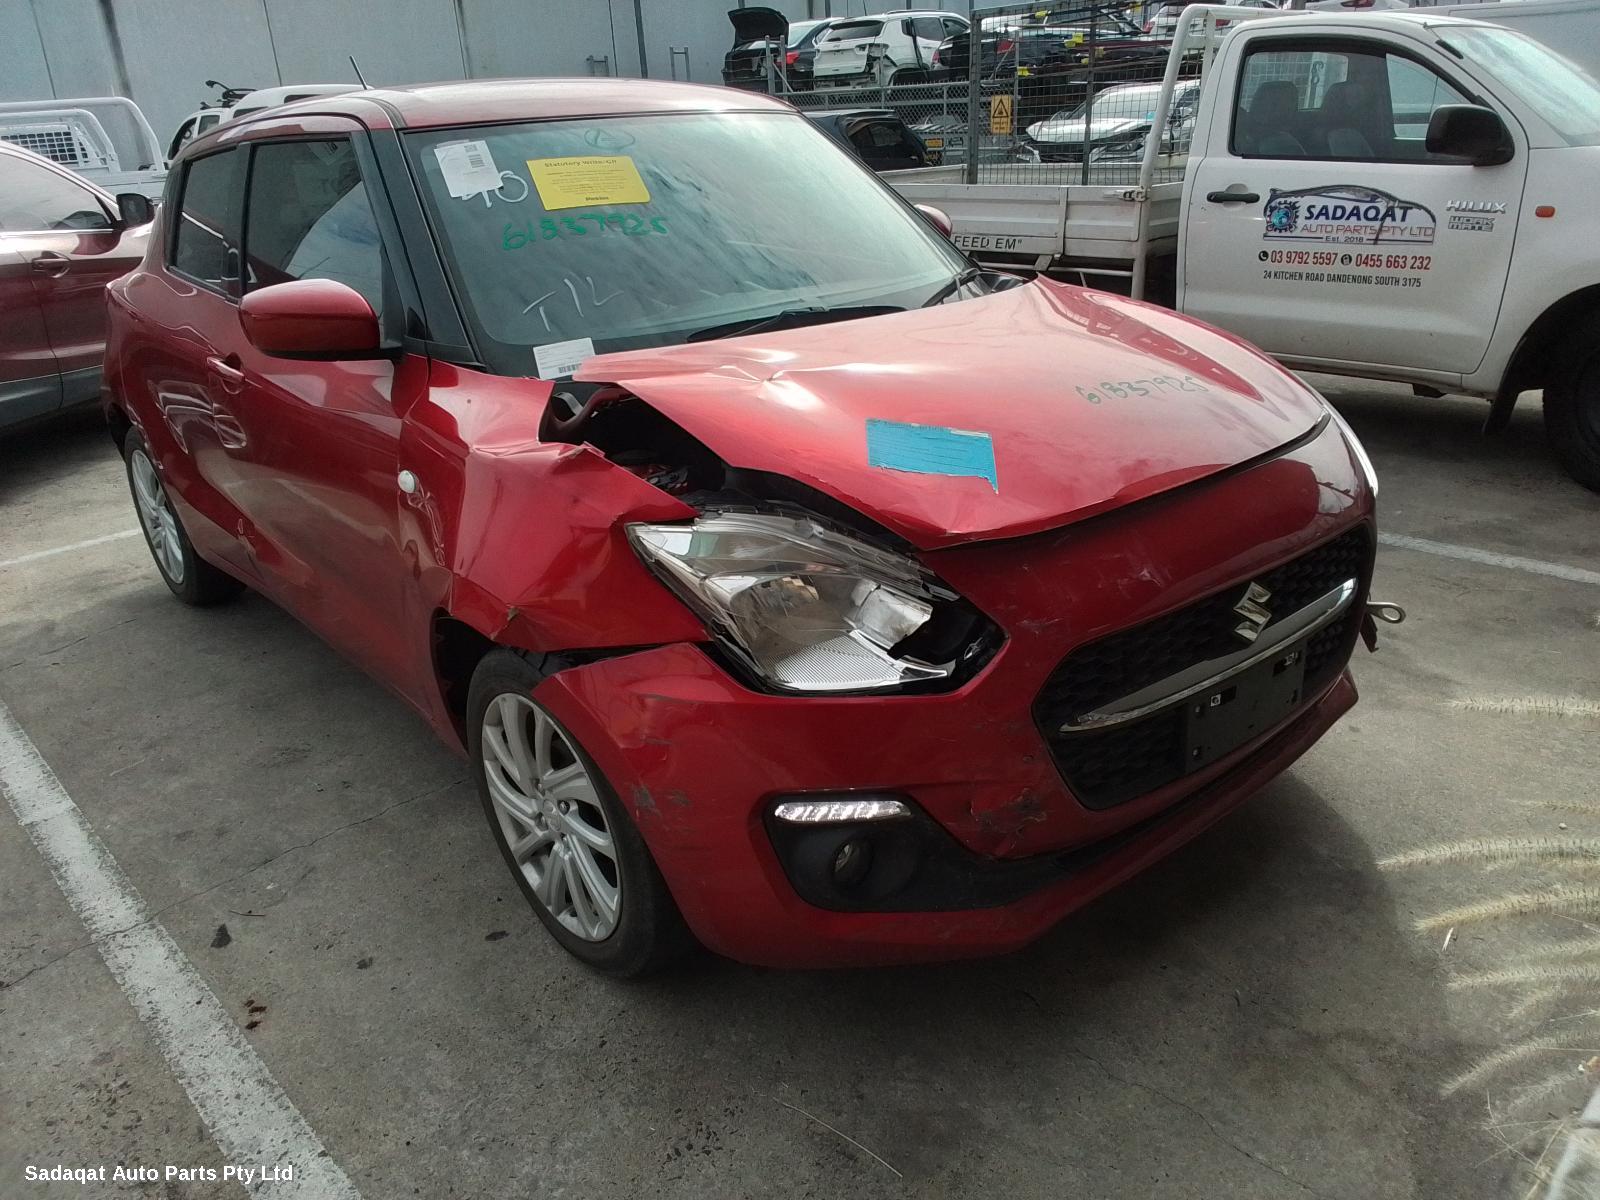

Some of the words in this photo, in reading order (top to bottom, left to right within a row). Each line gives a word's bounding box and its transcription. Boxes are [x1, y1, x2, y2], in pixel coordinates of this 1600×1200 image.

[1304, 204, 1414, 223] SADAQAT
[1446, 200, 1507, 214] HILUX
[1301, 224, 1334, 234] AUTO
[1336, 224, 1377, 235] PARTS
[1380, 225, 1407, 236] PTY
[1409, 226, 1434, 237] LTD
[954, 235, 990, 249] FEED
[1270, 250, 1283, 264] 03
[1286, 251, 1309, 265] 9792
[1312, 252, 1338, 266] 5597
[1355, 253, 1383, 268] 0455
[1386, 254, 1407, 269] 663
[1409, 255, 1432, 270] 232
[1263, 270, 1272, 280] 24
[1273, 270, 1304, 281] KITCHEN
[1305, 272, 1325, 282] ROAD
[1326, 272, 1373, 285] DANDENONG
[1374, 275, 1400, 286] SOUTH
[1402, 277, 1422, 288] 3175
